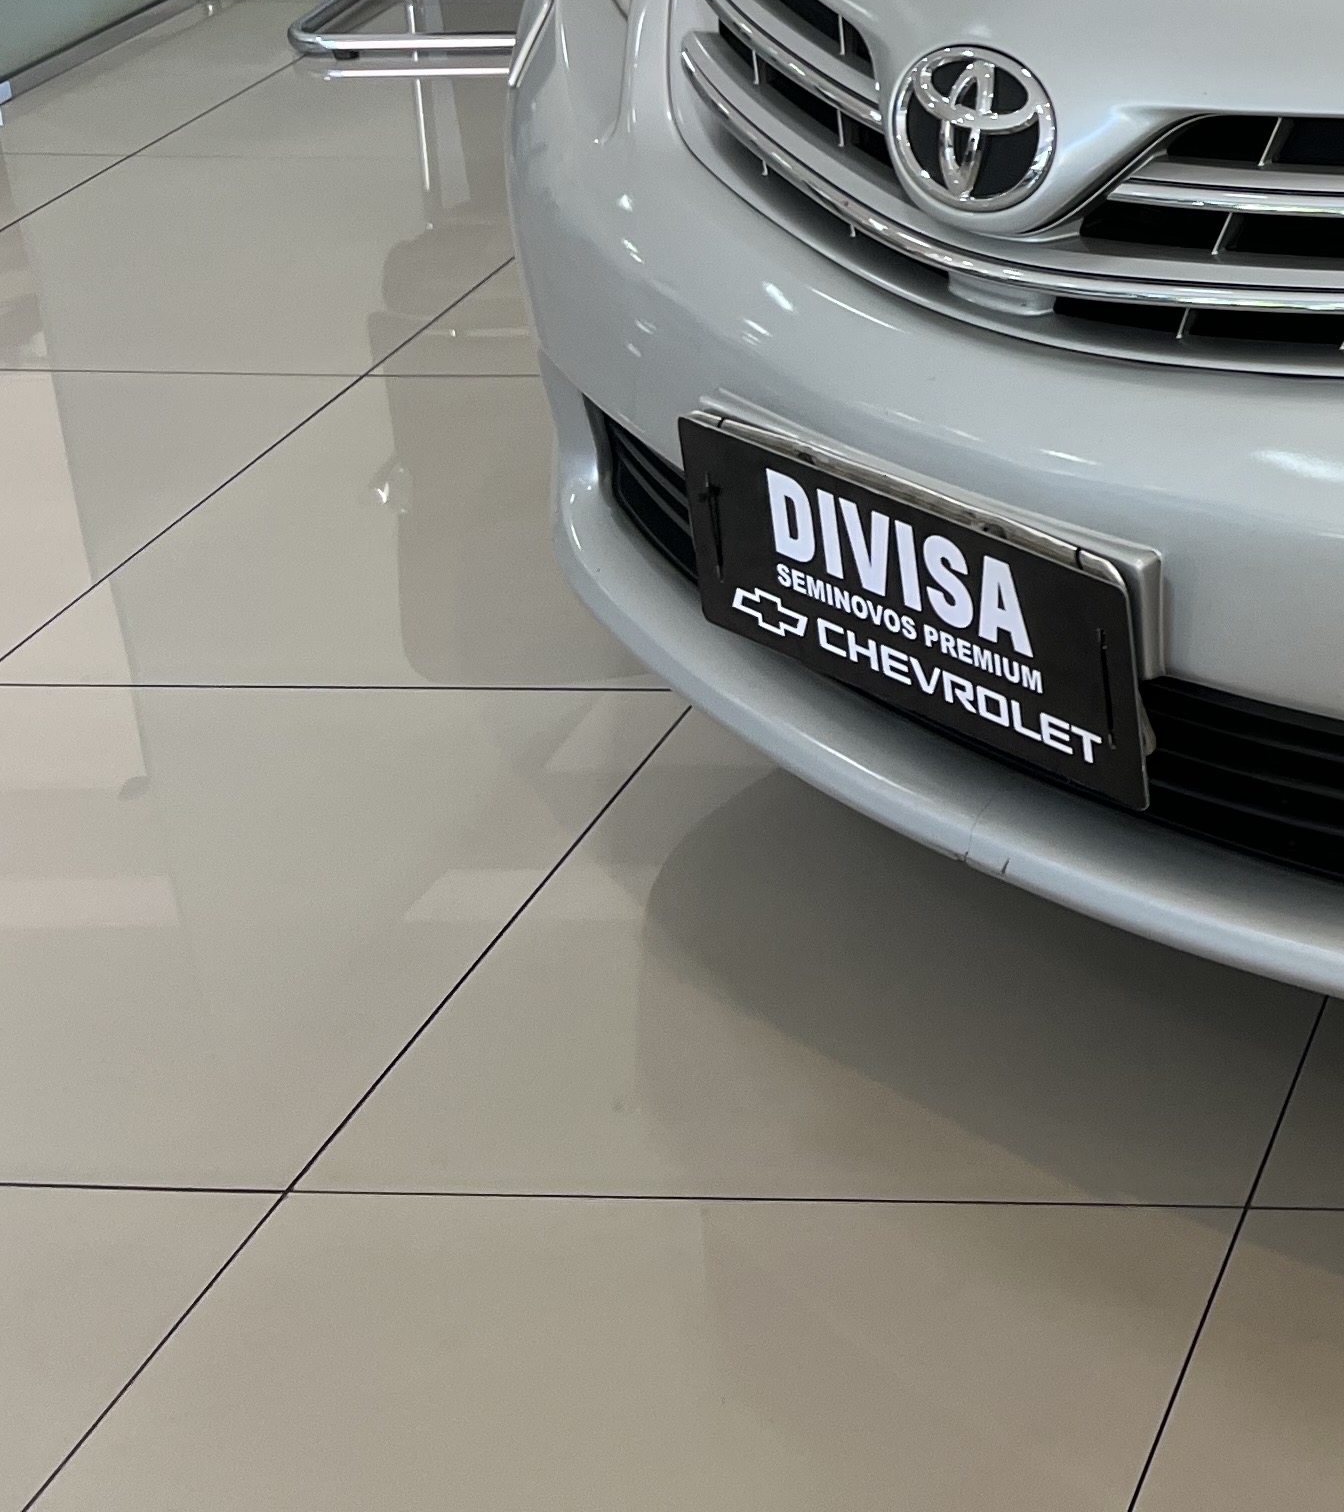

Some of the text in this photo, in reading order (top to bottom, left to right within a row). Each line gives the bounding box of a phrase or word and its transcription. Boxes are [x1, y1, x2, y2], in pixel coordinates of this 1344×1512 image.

[765, 467, 1034, 659] DIVISA
[776, 563, 1044, 695] SEMINOVOS PREMIUM
[816, 617, 1103, 764] CHEVROLET
